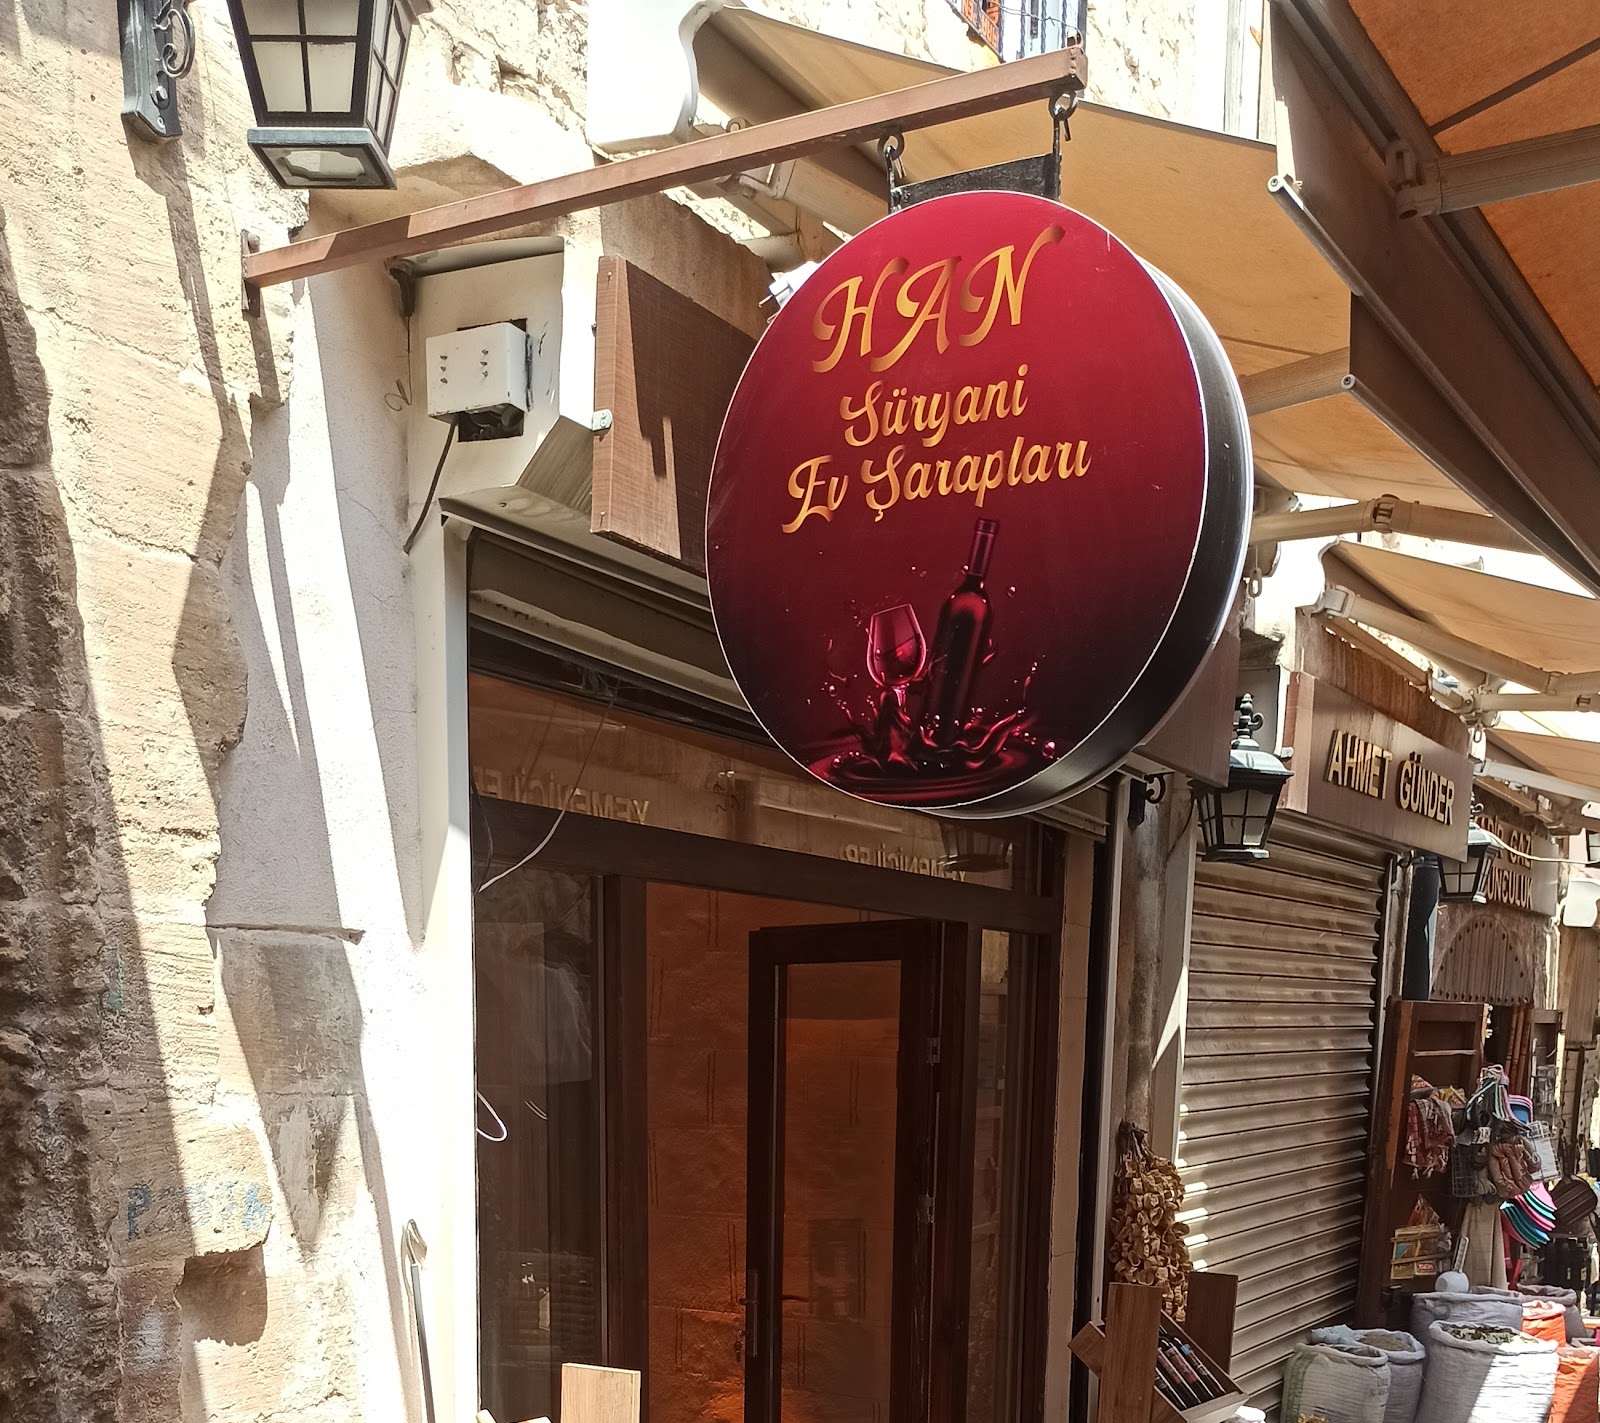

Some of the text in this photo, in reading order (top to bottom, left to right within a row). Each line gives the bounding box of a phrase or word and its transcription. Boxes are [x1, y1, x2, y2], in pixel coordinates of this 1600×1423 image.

[811, 224, 1067, 374] HAN
[839, 363, 1029, 448] Süryani
[781, 436, 1092, 534] Ev Şarapları
[1327, 730, 1455, 826] AHMET GÜNDER
[1485, 865, 1534, 911] UNCULUK
